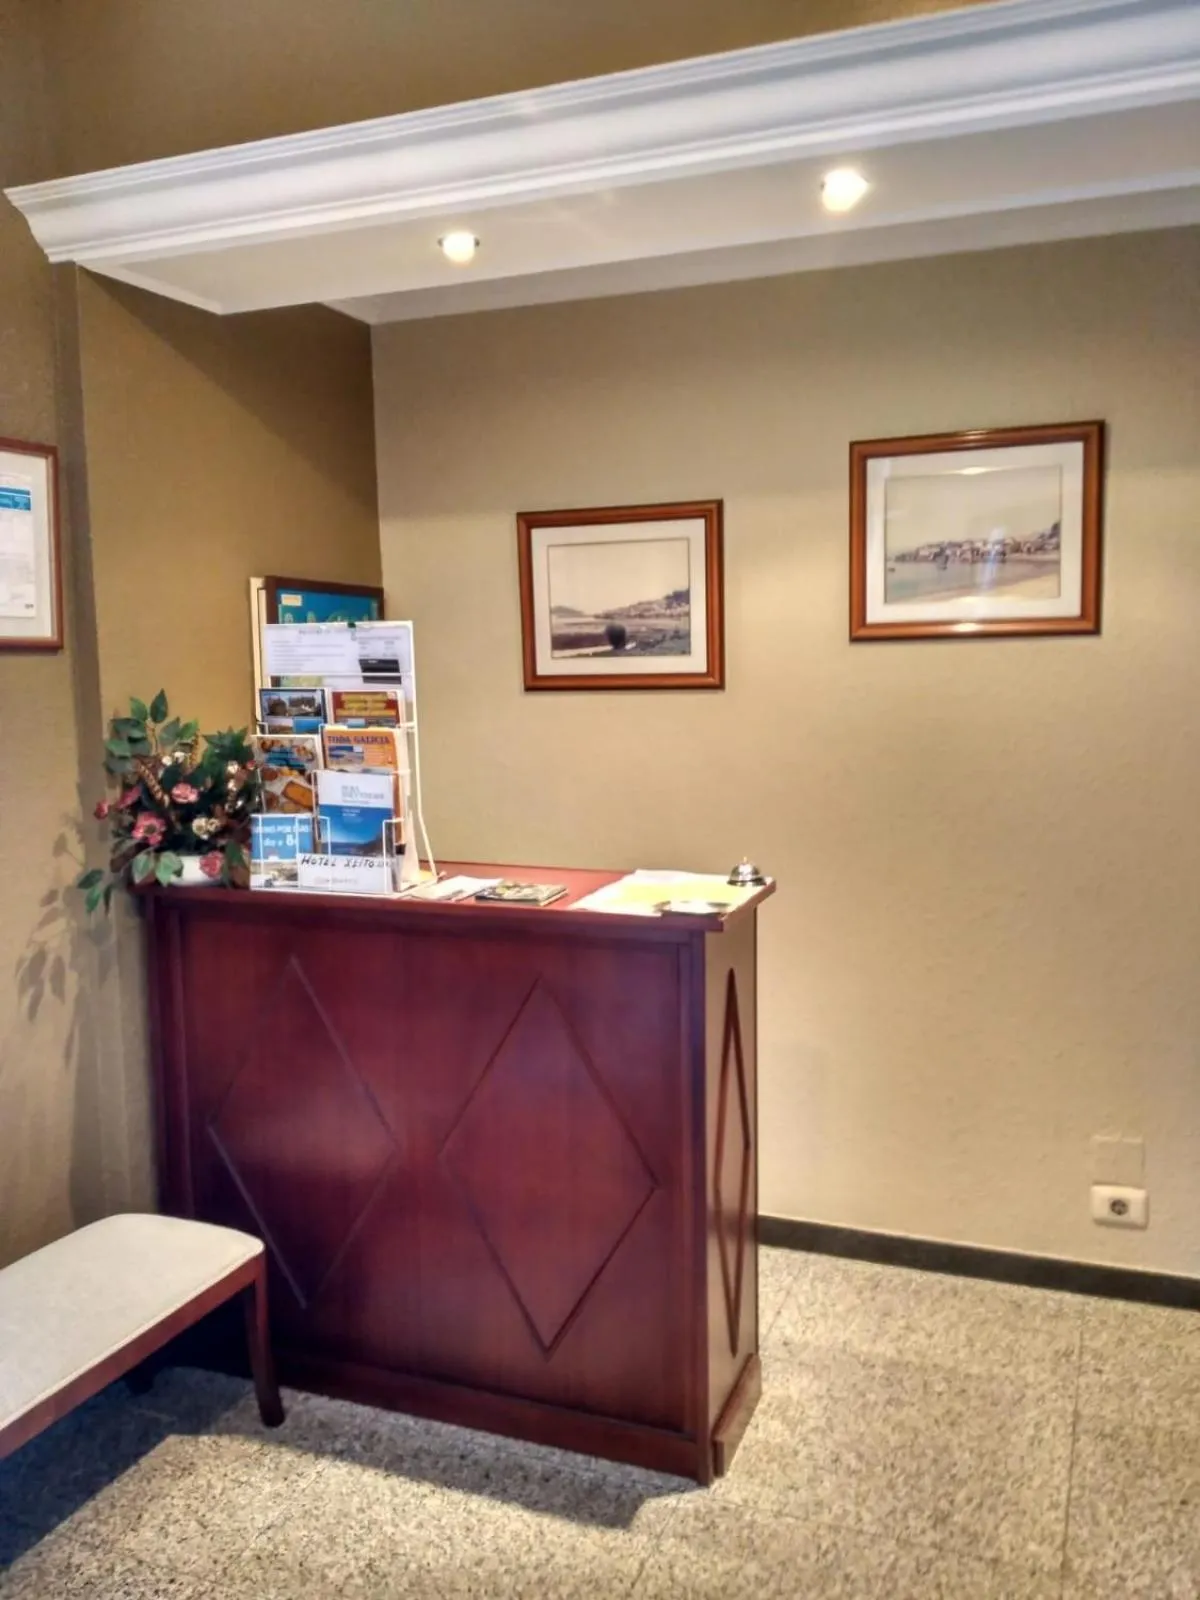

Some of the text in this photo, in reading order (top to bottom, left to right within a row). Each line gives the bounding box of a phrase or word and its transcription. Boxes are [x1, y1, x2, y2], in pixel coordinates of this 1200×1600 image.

[327, 735, 391, 745] TODA GALICIA
[301, 855, 337, 867] HOTEL
